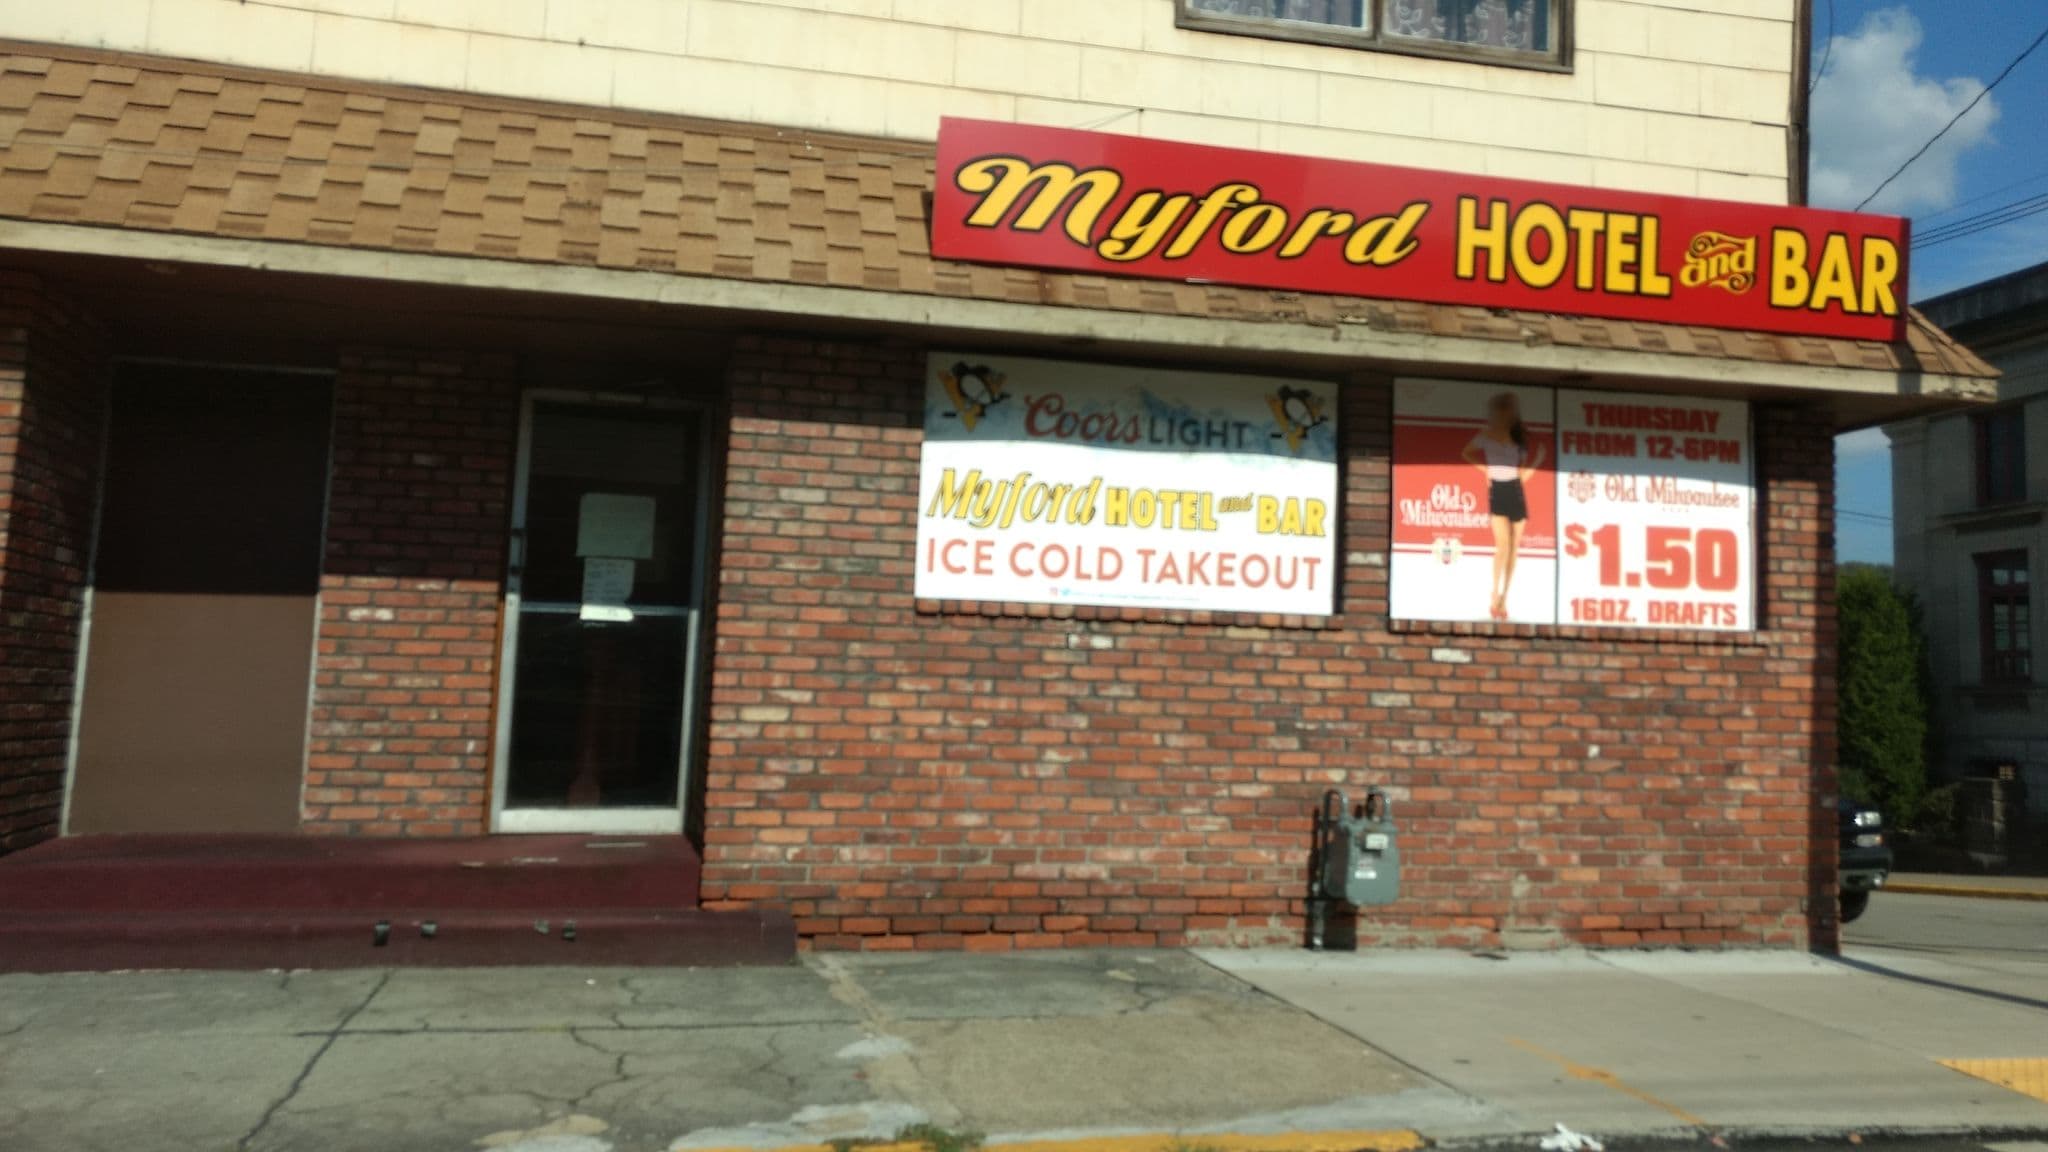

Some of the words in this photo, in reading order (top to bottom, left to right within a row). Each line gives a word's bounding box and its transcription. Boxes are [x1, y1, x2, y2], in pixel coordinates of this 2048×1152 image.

[955, 154, 1432, 268] Myford
[1456, 194, 1672, 298] HOTEL
[1679, 231, 1757, 295] and
[1769, 226, 1899, 316] BAR
[1024, 393, 1142, 442] Coors
[1148, 417, 1249, 449] LIGHT
[1581, 403, 1720, 433] THURSDAY
[1562, 431, 1637, 457] FROM
[1645, 436, 1741, 464] 12-6PM
[927, 467, 1103, 529] Myford
[1104, 486, 1217, 531] HOTEL
[1218, 494, 1254, 514] and
[1256, 494, 1327, 537] BAR
[1431, 484, 1461, 511] Old
[1605, 472, 1638, 502] Old
[1645, 473, 1740, 507] Milwaukee
[927, 537, 995, 576] ICE
[1009, 541, 1124, 582] COLD
[1136, 548, 1321, 591] TAKEOUT
[1564, 523, 1739, 592] $1.50
[1648, 600, 1737, 626] DRAFTS
